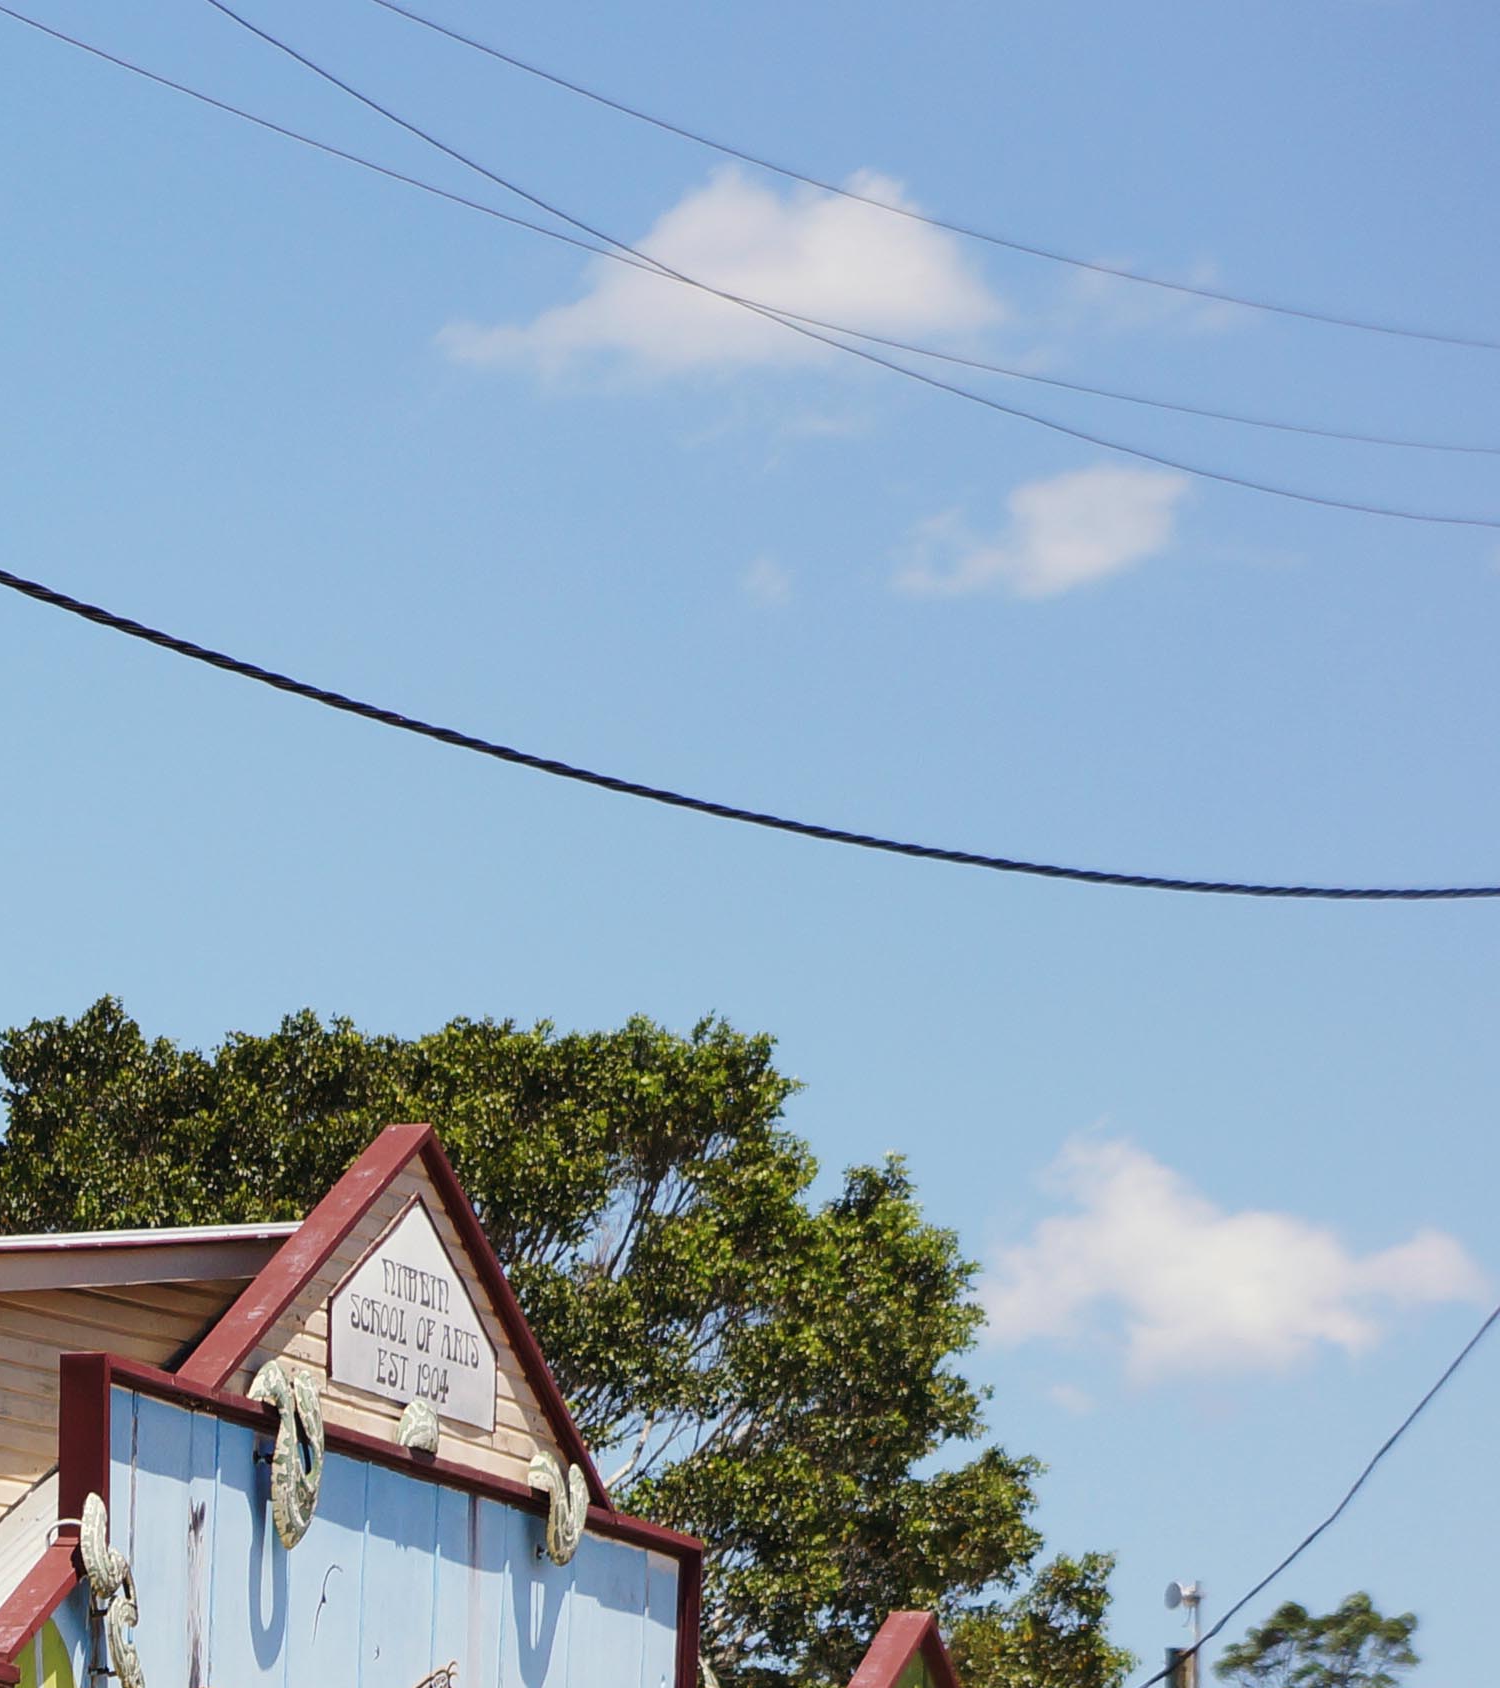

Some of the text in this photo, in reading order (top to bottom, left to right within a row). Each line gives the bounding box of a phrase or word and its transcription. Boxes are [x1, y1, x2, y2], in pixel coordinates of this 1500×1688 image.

[382, 1258, 449, 1315] NIMBIN
[350, 1293, 479, 1369] SCHOOL OF ARTS
[376, 1347, 449, 1404] EST 1904
